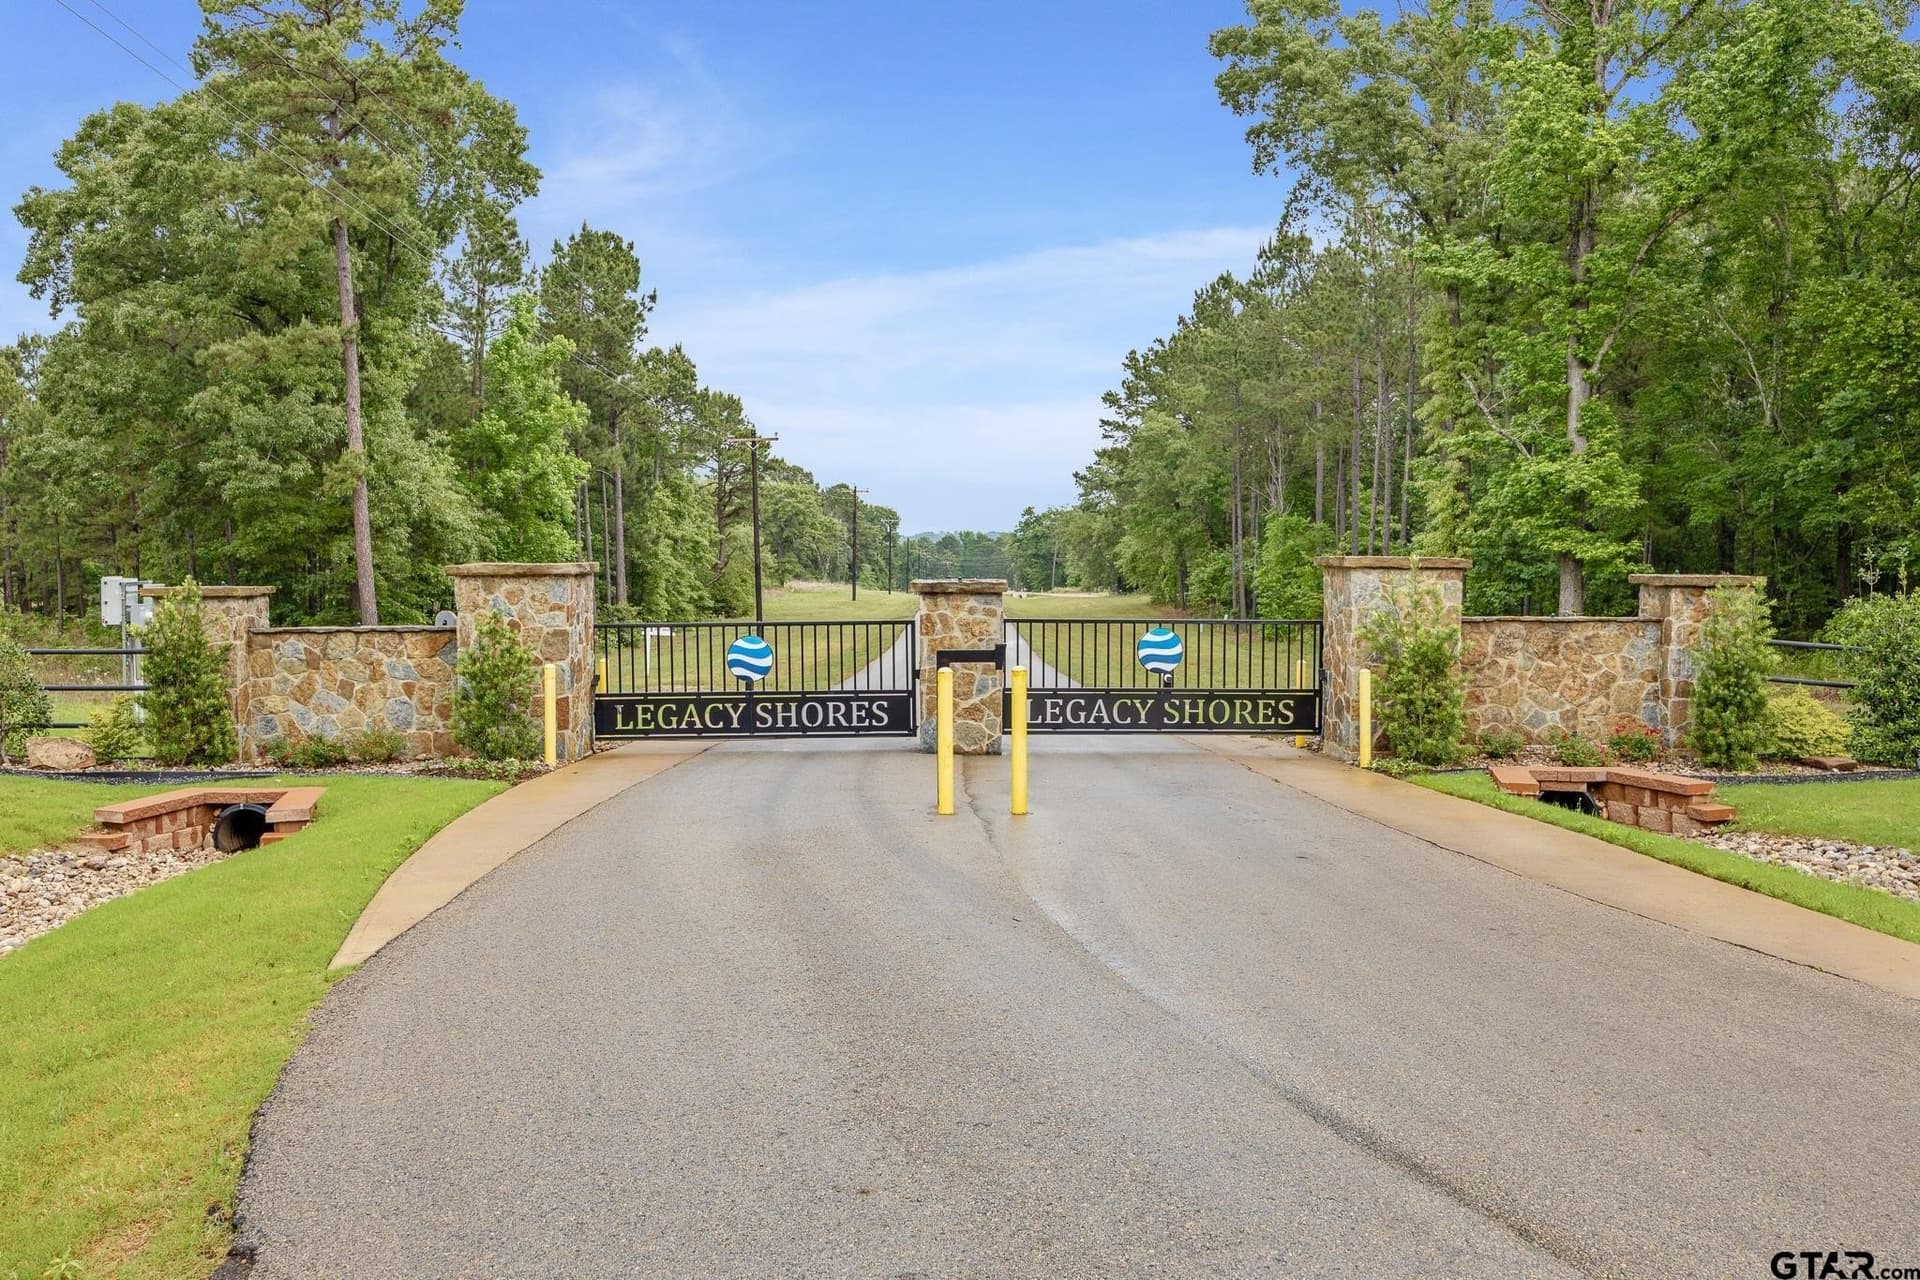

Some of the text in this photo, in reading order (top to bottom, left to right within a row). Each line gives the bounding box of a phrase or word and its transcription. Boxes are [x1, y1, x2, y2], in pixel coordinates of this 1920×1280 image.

[614, 700, 889, 730] LEGACY SHORES
[1026, 698, 1295, 725] LEGACY SHORES
